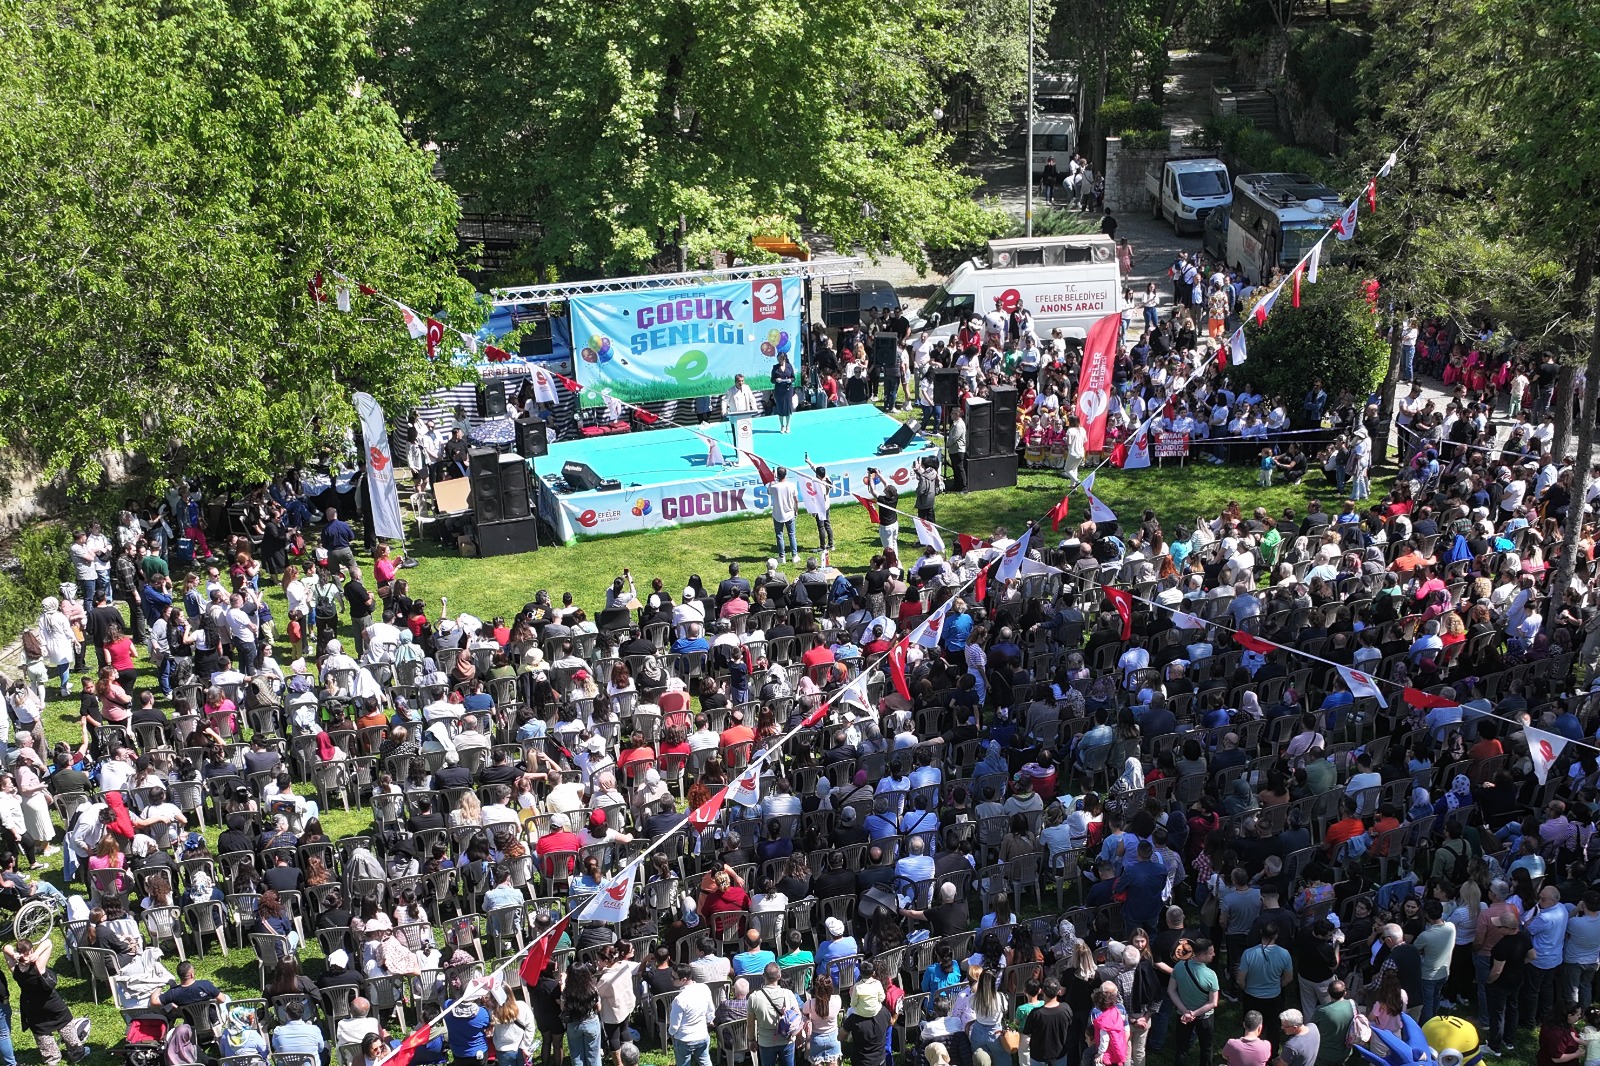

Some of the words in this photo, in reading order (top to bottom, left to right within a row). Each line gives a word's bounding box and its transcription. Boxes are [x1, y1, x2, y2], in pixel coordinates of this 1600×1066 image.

[1065, 284, 1078, 293] T.C.
[668, 292, 706, 301] EFELER
[1035, 294, 1064, 303] EFELER
[1065, 290, 1108, 302] BELEDİYESİ
[1040, 303, 1073, 313] ANONS
[1075, 302, 1104, 312] ARACI
[637, 298, 735, 330] ÇOCUK
[630, 321, 745, 356] ŞENLİĞİ
[1089, 352, 1102, 389] EFELER
[734, 479, 763, 488] EFEL
[661, 488, 748, 521] ÇOCUK
[597, 510, 621, 519] EFELER
